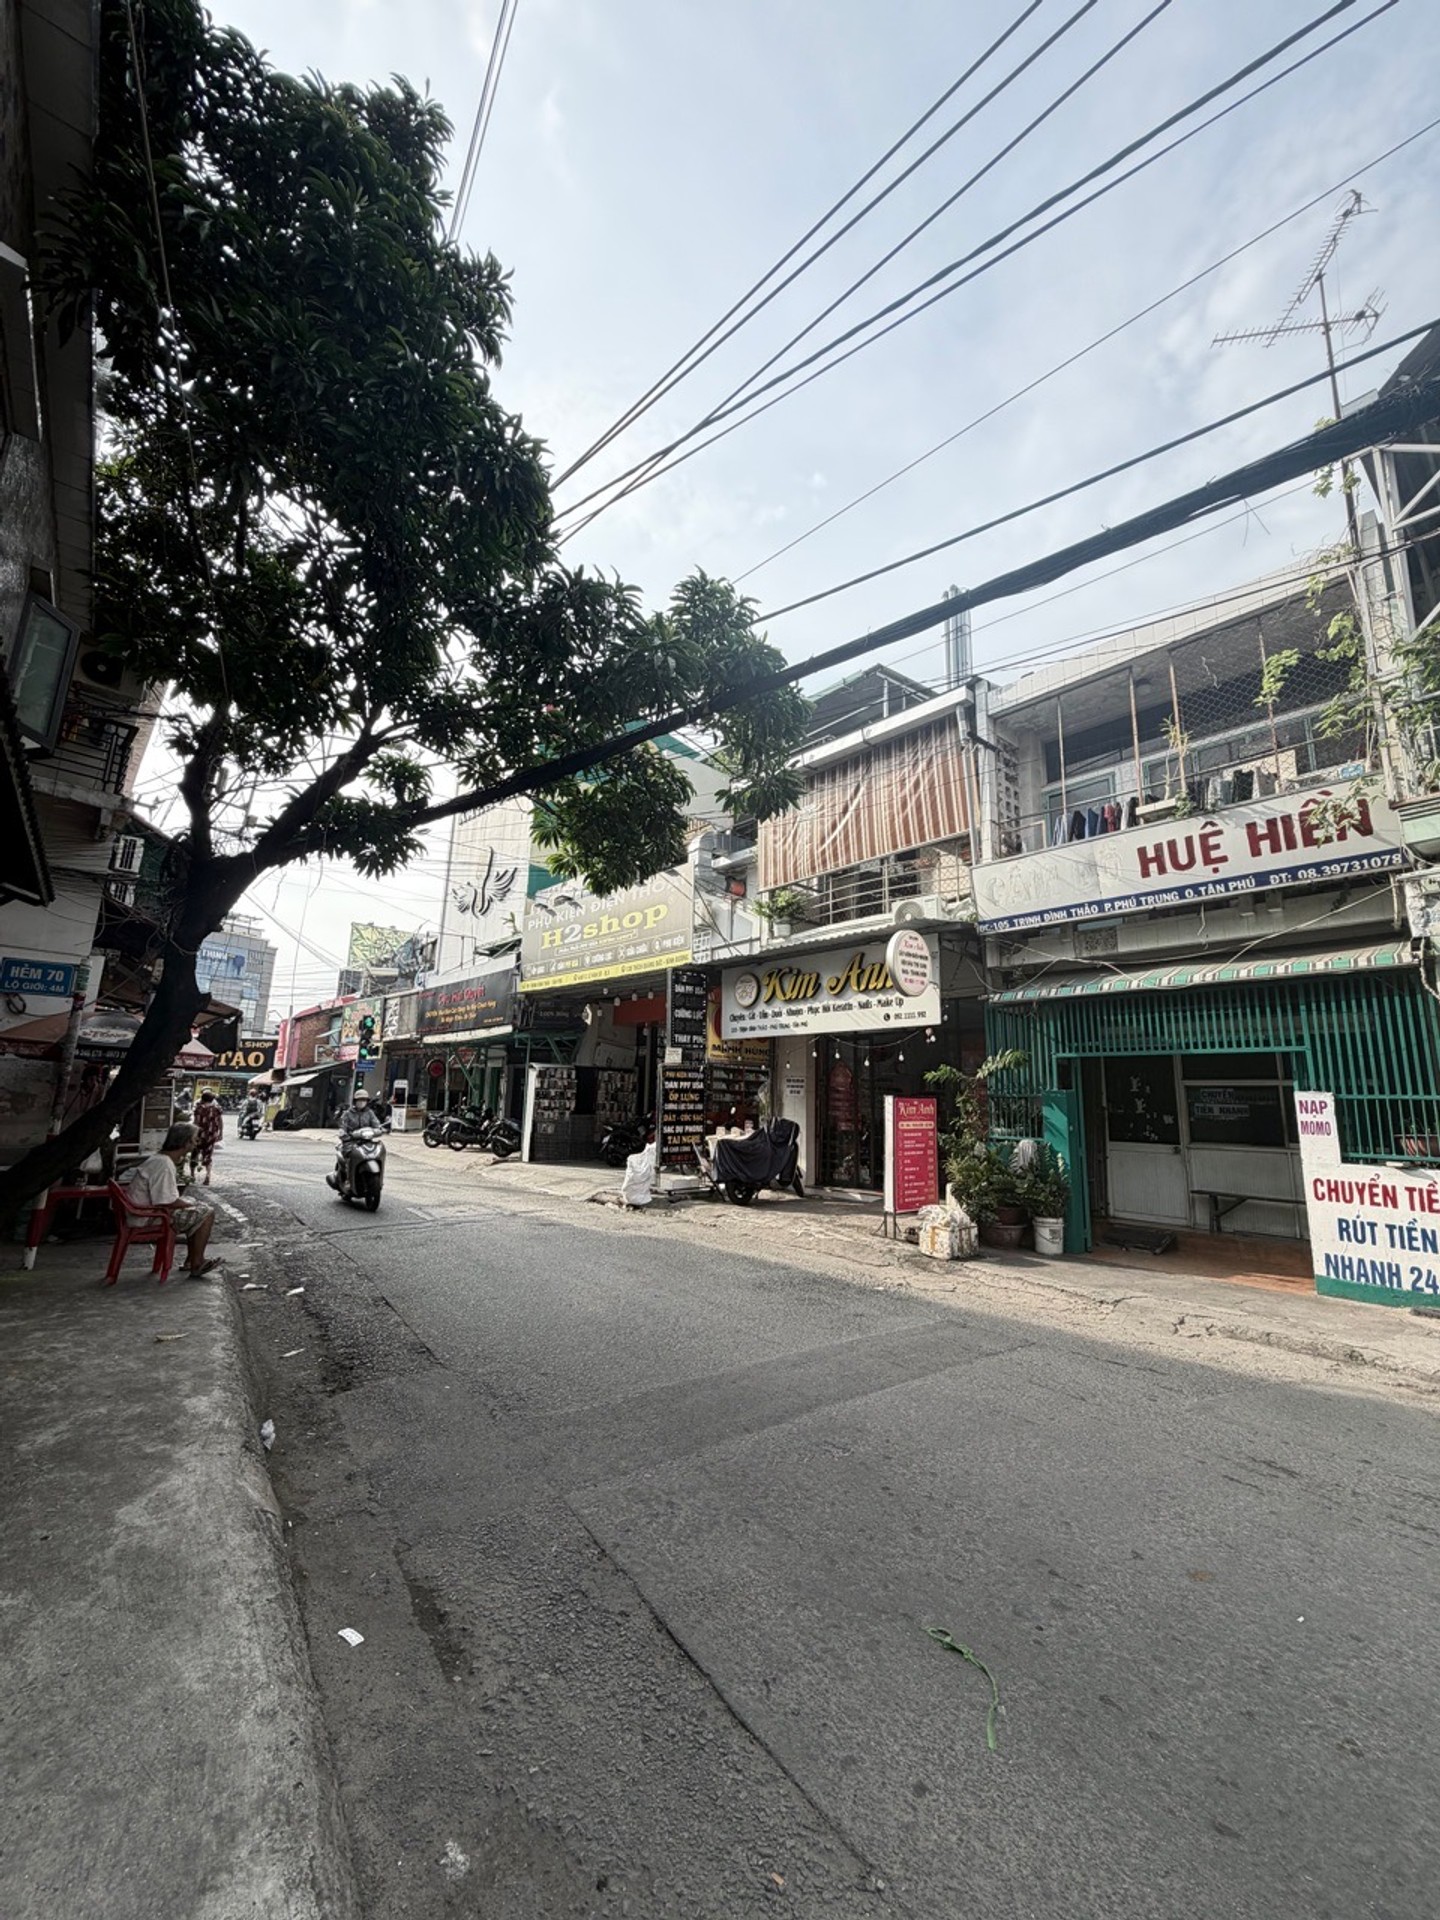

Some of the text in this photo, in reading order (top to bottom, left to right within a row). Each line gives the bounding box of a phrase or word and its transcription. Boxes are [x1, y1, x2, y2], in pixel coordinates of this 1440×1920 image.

[1137, 789, 1374, 878] HUỆ HIỀN
[1071, 903, 1099, 918] THẢO
[1139, 890, 1180, 906] TRUNG
[1199, 882, 1226, 897] TÂN
[1228, 874, 1256, 891] PHÚ
[1298, 852, 1403, 880] 08.39731078
[541, 904, 669, 949] H2shop
[10, 963, 65, 982] HẺM 70
[48, 984, 65, 993] 4M
[762, 967, 822, 1003] Kim
[216, 1050, 265, 1070] TẠO
[245, 1041, 273, 1049] SHOP
[1299, 1100, 1328, 1119] NẠP
[1300, 1120, 1332, 1137] MOMO
[1312, 1173, 1399, 1210] CHUYỂN
[1337, 1213, 1439, 1255] RÚT TIỀN
[1324, 1252, 1403, 1289] NHANH
